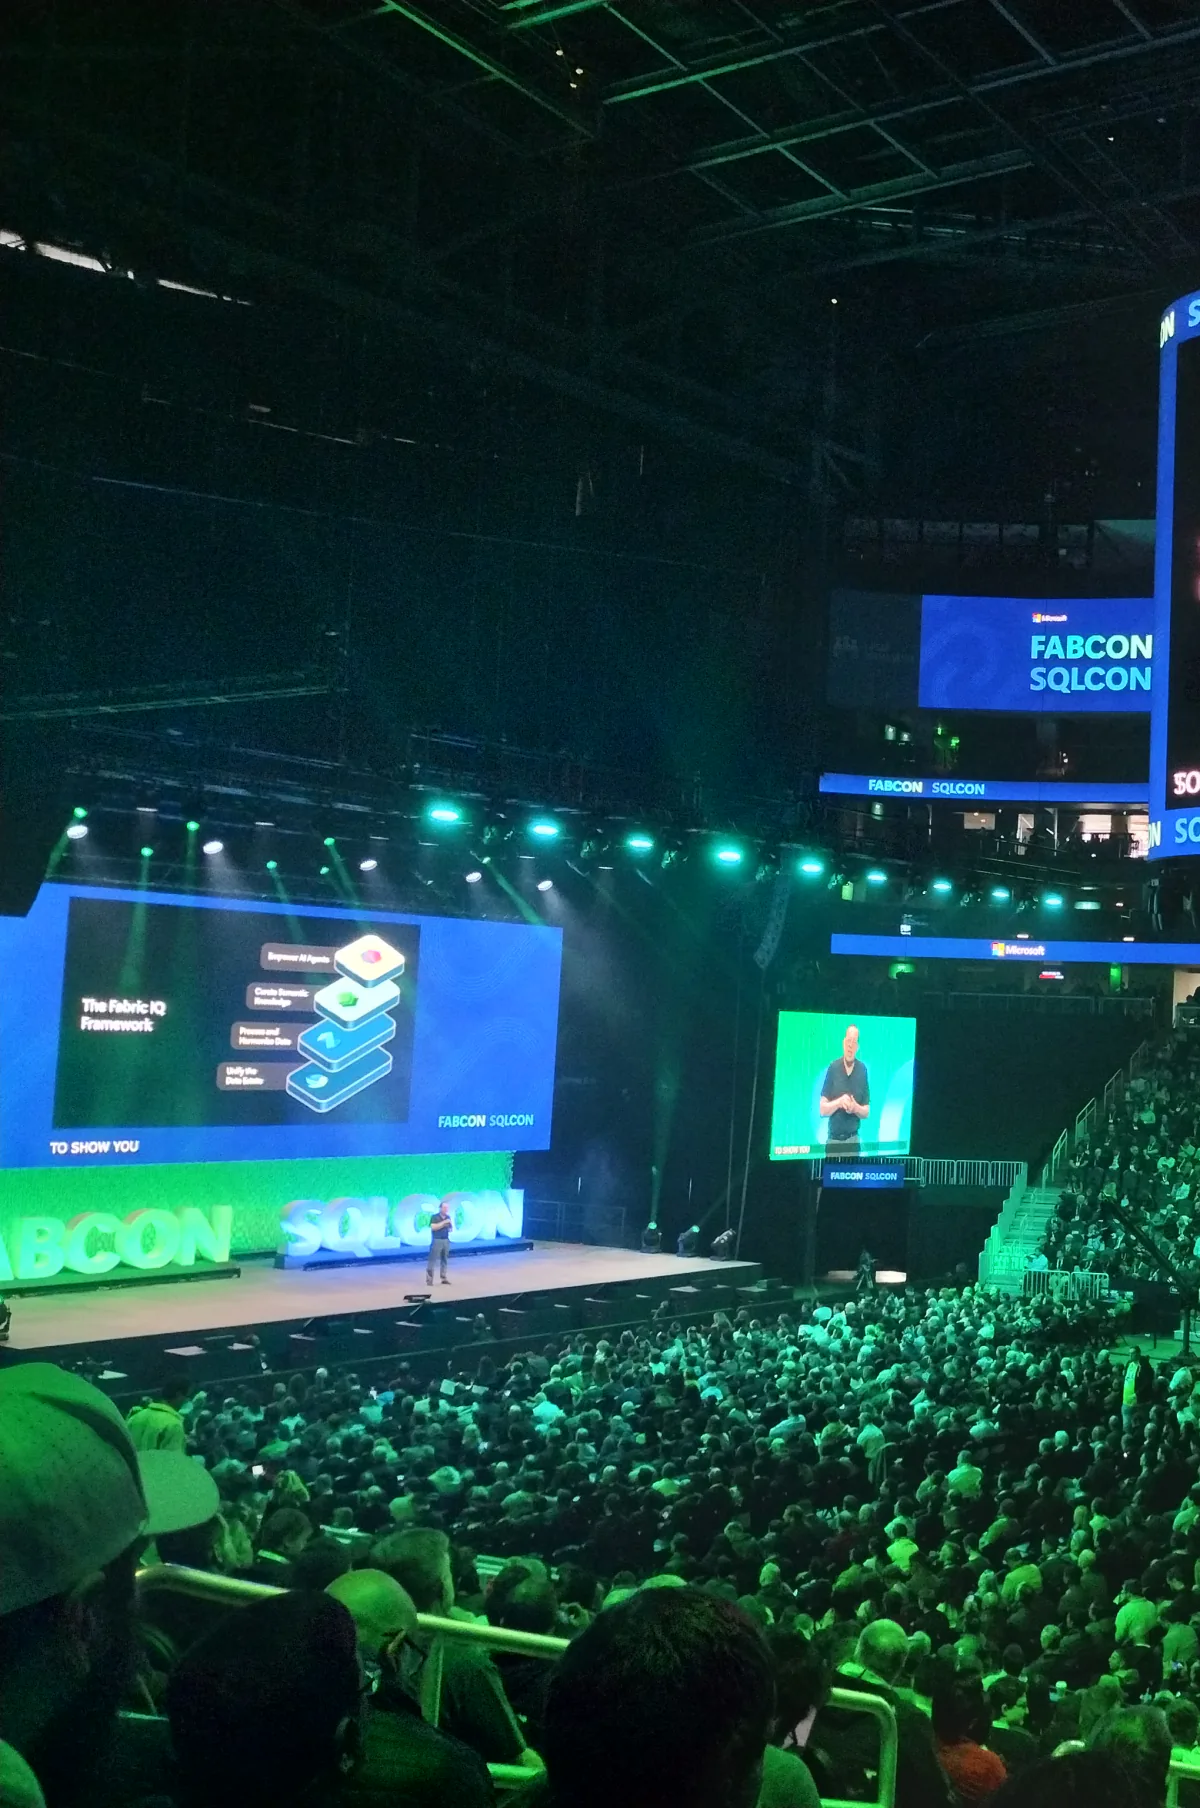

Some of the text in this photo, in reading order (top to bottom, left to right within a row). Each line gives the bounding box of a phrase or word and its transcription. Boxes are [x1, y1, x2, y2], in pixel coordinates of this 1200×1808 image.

[1030, 634, 1153, 660] FABCON
[1030, 667, 1151, 693] SQLCON
[869, 779, 985, 795] FABCON SQLCON
[1005, 945, 1045, 957] Microsoft
[81, 998, 167, 1017] The Fabric IQ
[80, 1016, 154, 1032] Framework
[438, 1114, 534, 1128] FABCON SQLCON
[50, 1140, 140, 1155] TO SHOW YOU
[830, 1172, 897, 1180] FABCON SQLCON
[278, 1188, 524, 1258] SQLCON
